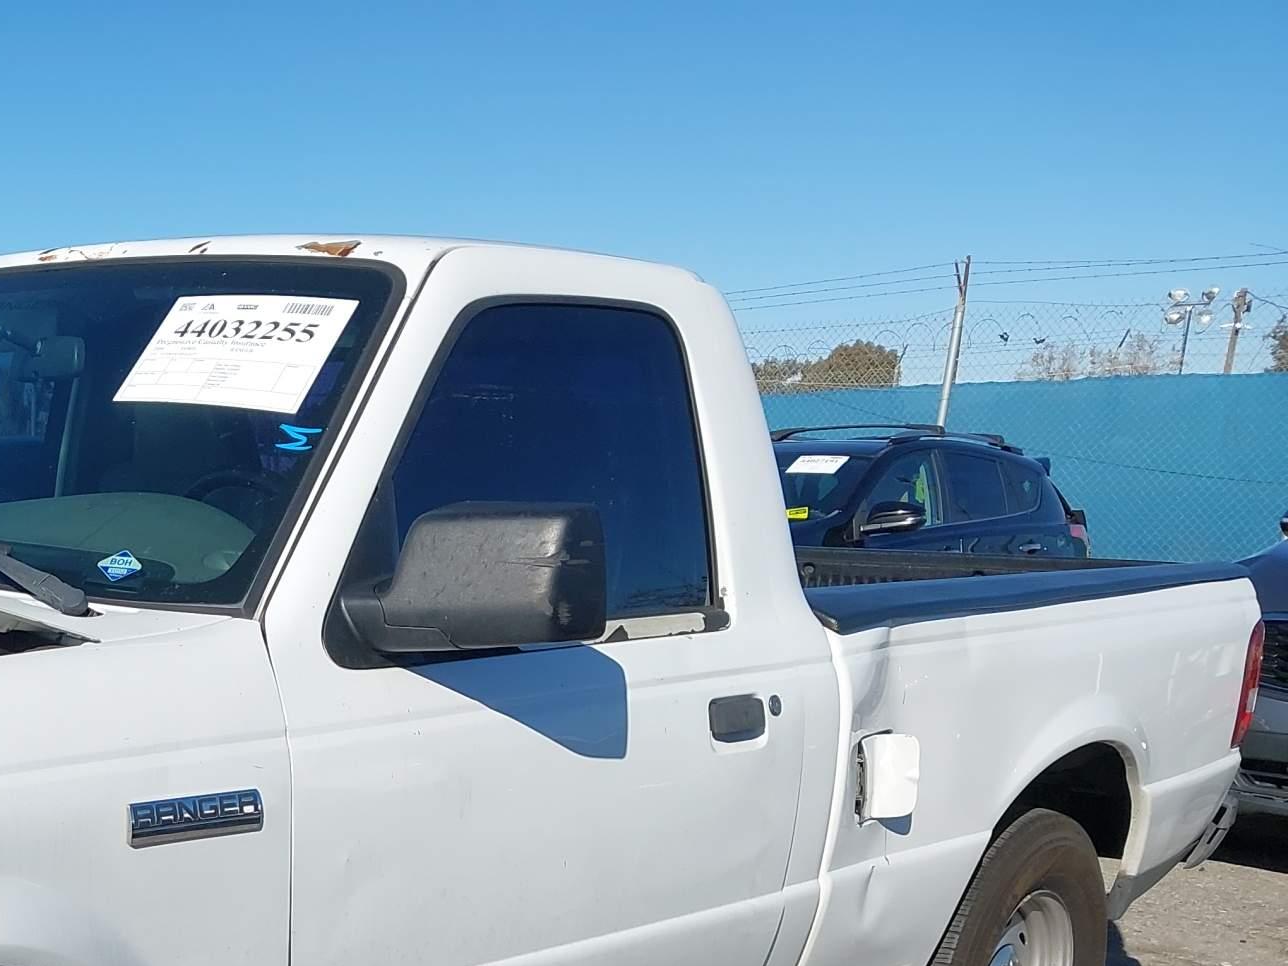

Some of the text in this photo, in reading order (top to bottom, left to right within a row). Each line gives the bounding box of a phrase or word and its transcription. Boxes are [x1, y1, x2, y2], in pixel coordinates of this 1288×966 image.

[173, 318, 320, 343] 44032255
[110, 558, 132, 567] BOH
[132, 791, 261, 829] RANGER
